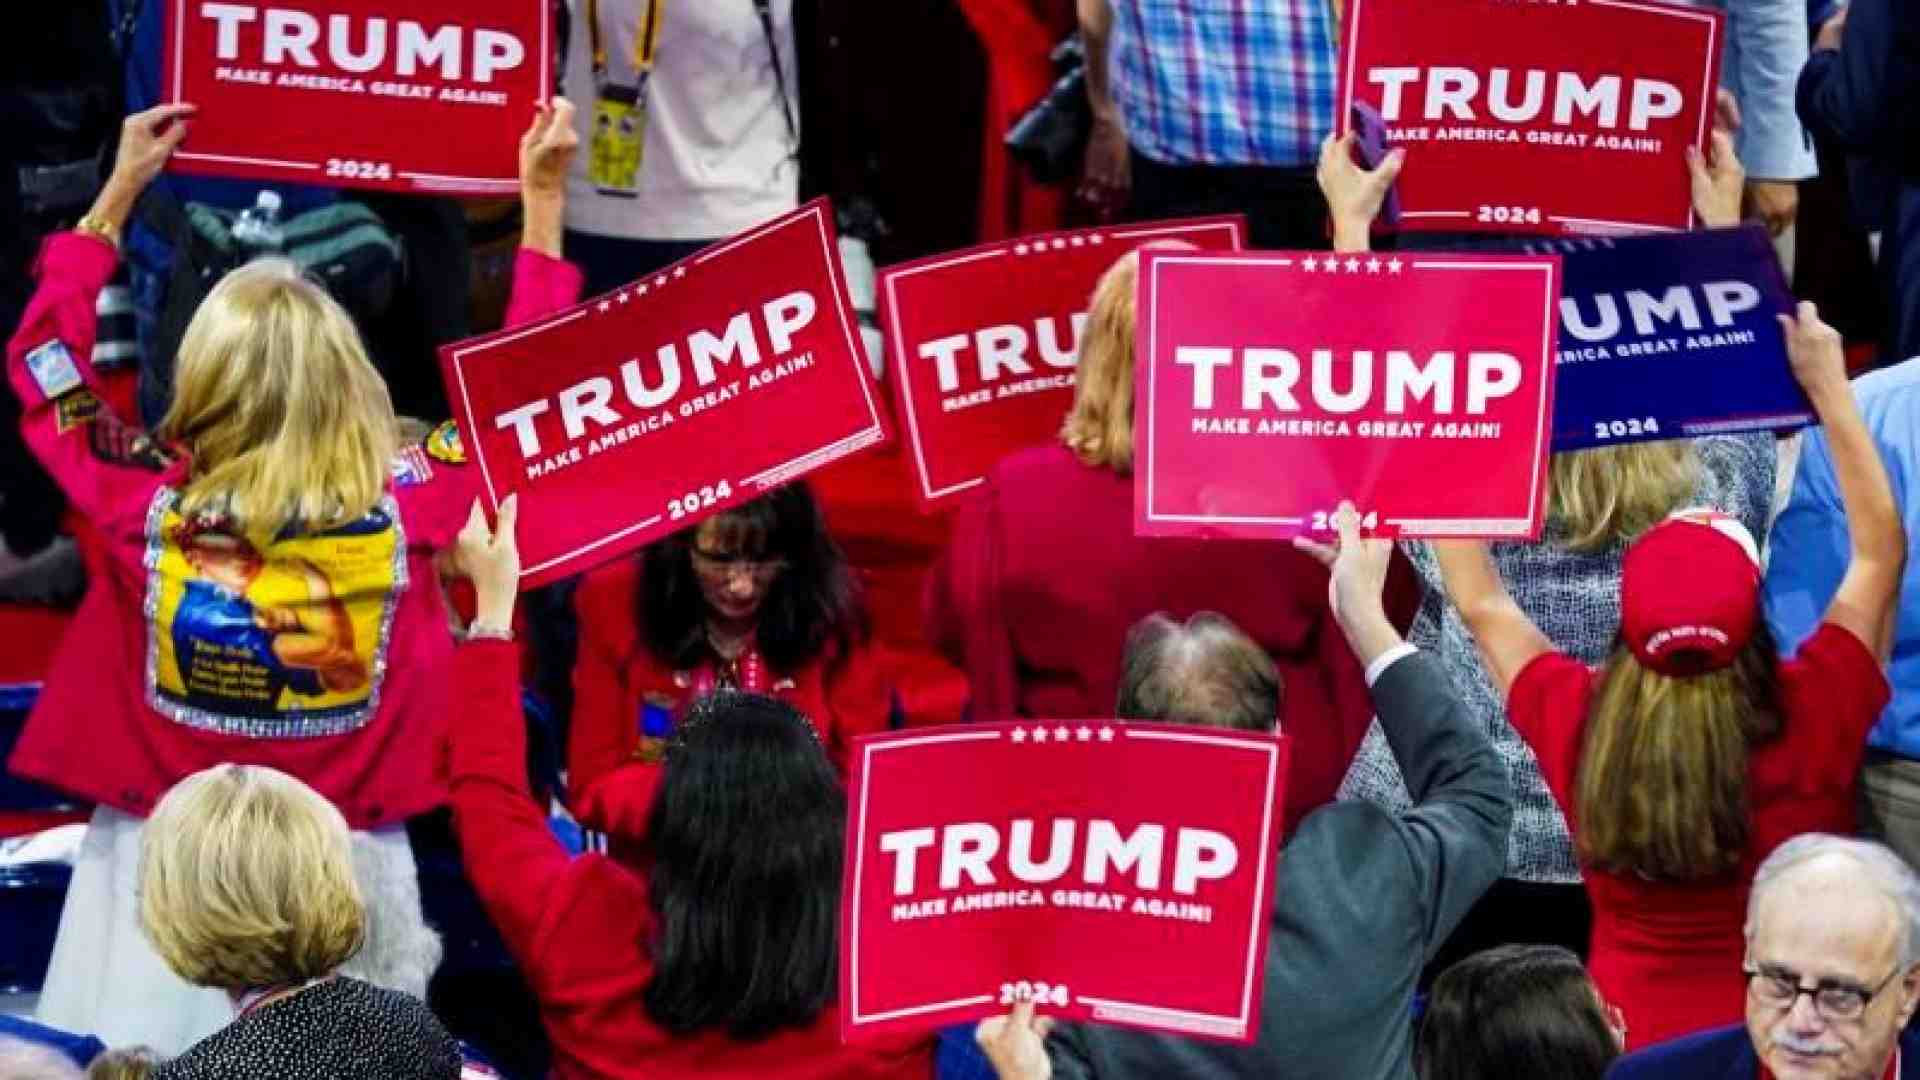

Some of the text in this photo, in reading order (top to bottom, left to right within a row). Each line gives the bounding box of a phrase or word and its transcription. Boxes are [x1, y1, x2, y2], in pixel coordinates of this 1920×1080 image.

[201, 3, 524, 82] TRUMP
[215, 66, 508, 106] MAKE AMERICA GREAT AGAIN!
[1367, 66, 1684, 130] TRUMP
[1436, 129, 1520, 144] AMERICA
[1526, 131, 1589, 147] GREAT
[1594, 135, 1662, 154] AGAIN!
[326, 159, 392, 181] 2024
[1477, 205, 1542, 225] 2024
[1559, 281, 1760, 342] UMP
[917, 312, 1089, 392] TRU
[1616, 339, 1678, 357] GREAT
[1687, 331, 1755, 350] AGAIN!
[495, 290, 816, 459] TRUMP
[1175, 346, 1522, 415] TRUMP
[525, 352, 815, 480] MAKE AMERICA GREAT AGAIN!
[1192, 418, 1500, 439] MAKE AMERICA GREAT AGAIN!
[1595, 417, 1659, 438] 2024
[667, 480, 732, 519] 2024
[880, 818, 1238, 896] TRUMP
[893, 890, 1212, 923] MAKE AMERICA GREAT AGAIN!
